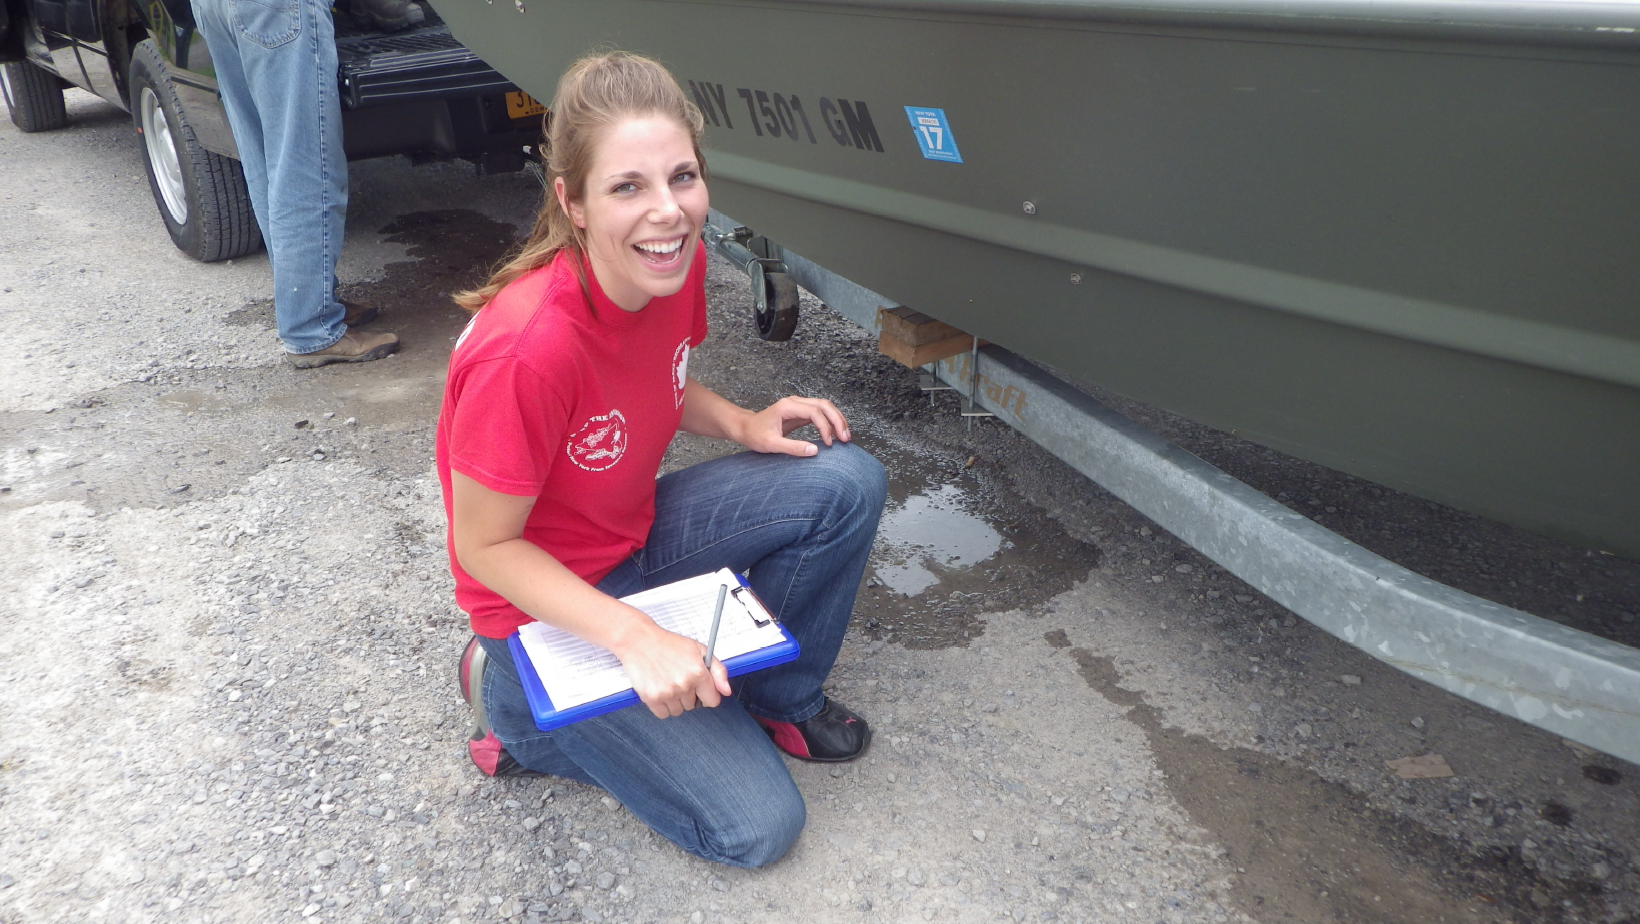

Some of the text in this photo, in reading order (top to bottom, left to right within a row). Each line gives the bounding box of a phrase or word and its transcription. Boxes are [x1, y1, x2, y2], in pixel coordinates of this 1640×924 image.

[688, 80, 885, 153] NY 7501 GM
[919, 125, 943, 150] 17
